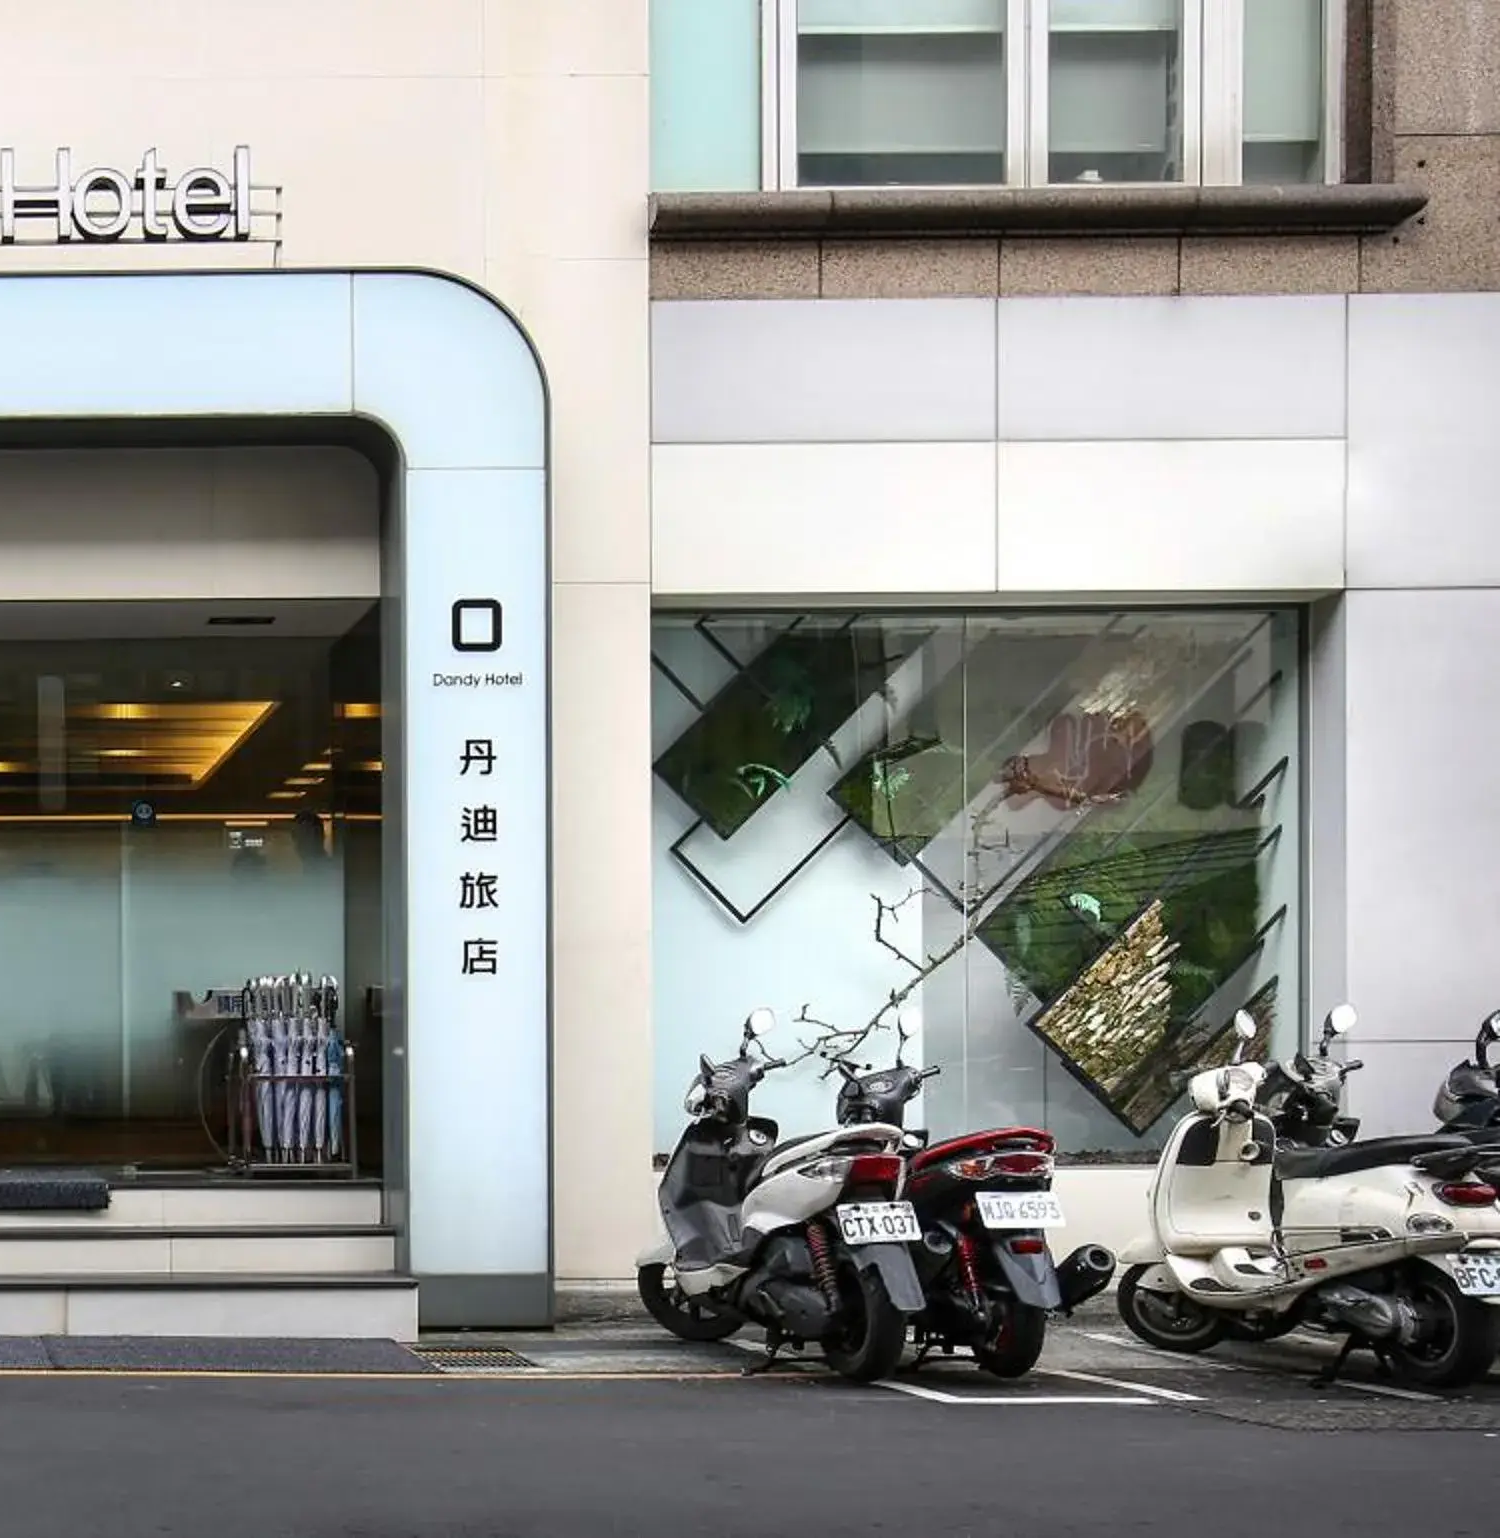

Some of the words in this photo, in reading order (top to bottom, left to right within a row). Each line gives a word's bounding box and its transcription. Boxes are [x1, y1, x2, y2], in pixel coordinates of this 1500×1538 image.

[0, 145, 251, 244] Hotel
[432, 672, 480, 688] Dandy
[485, 672, 523, 686] Hotel
[459, 738, 499, 976] 丹迪旅店
